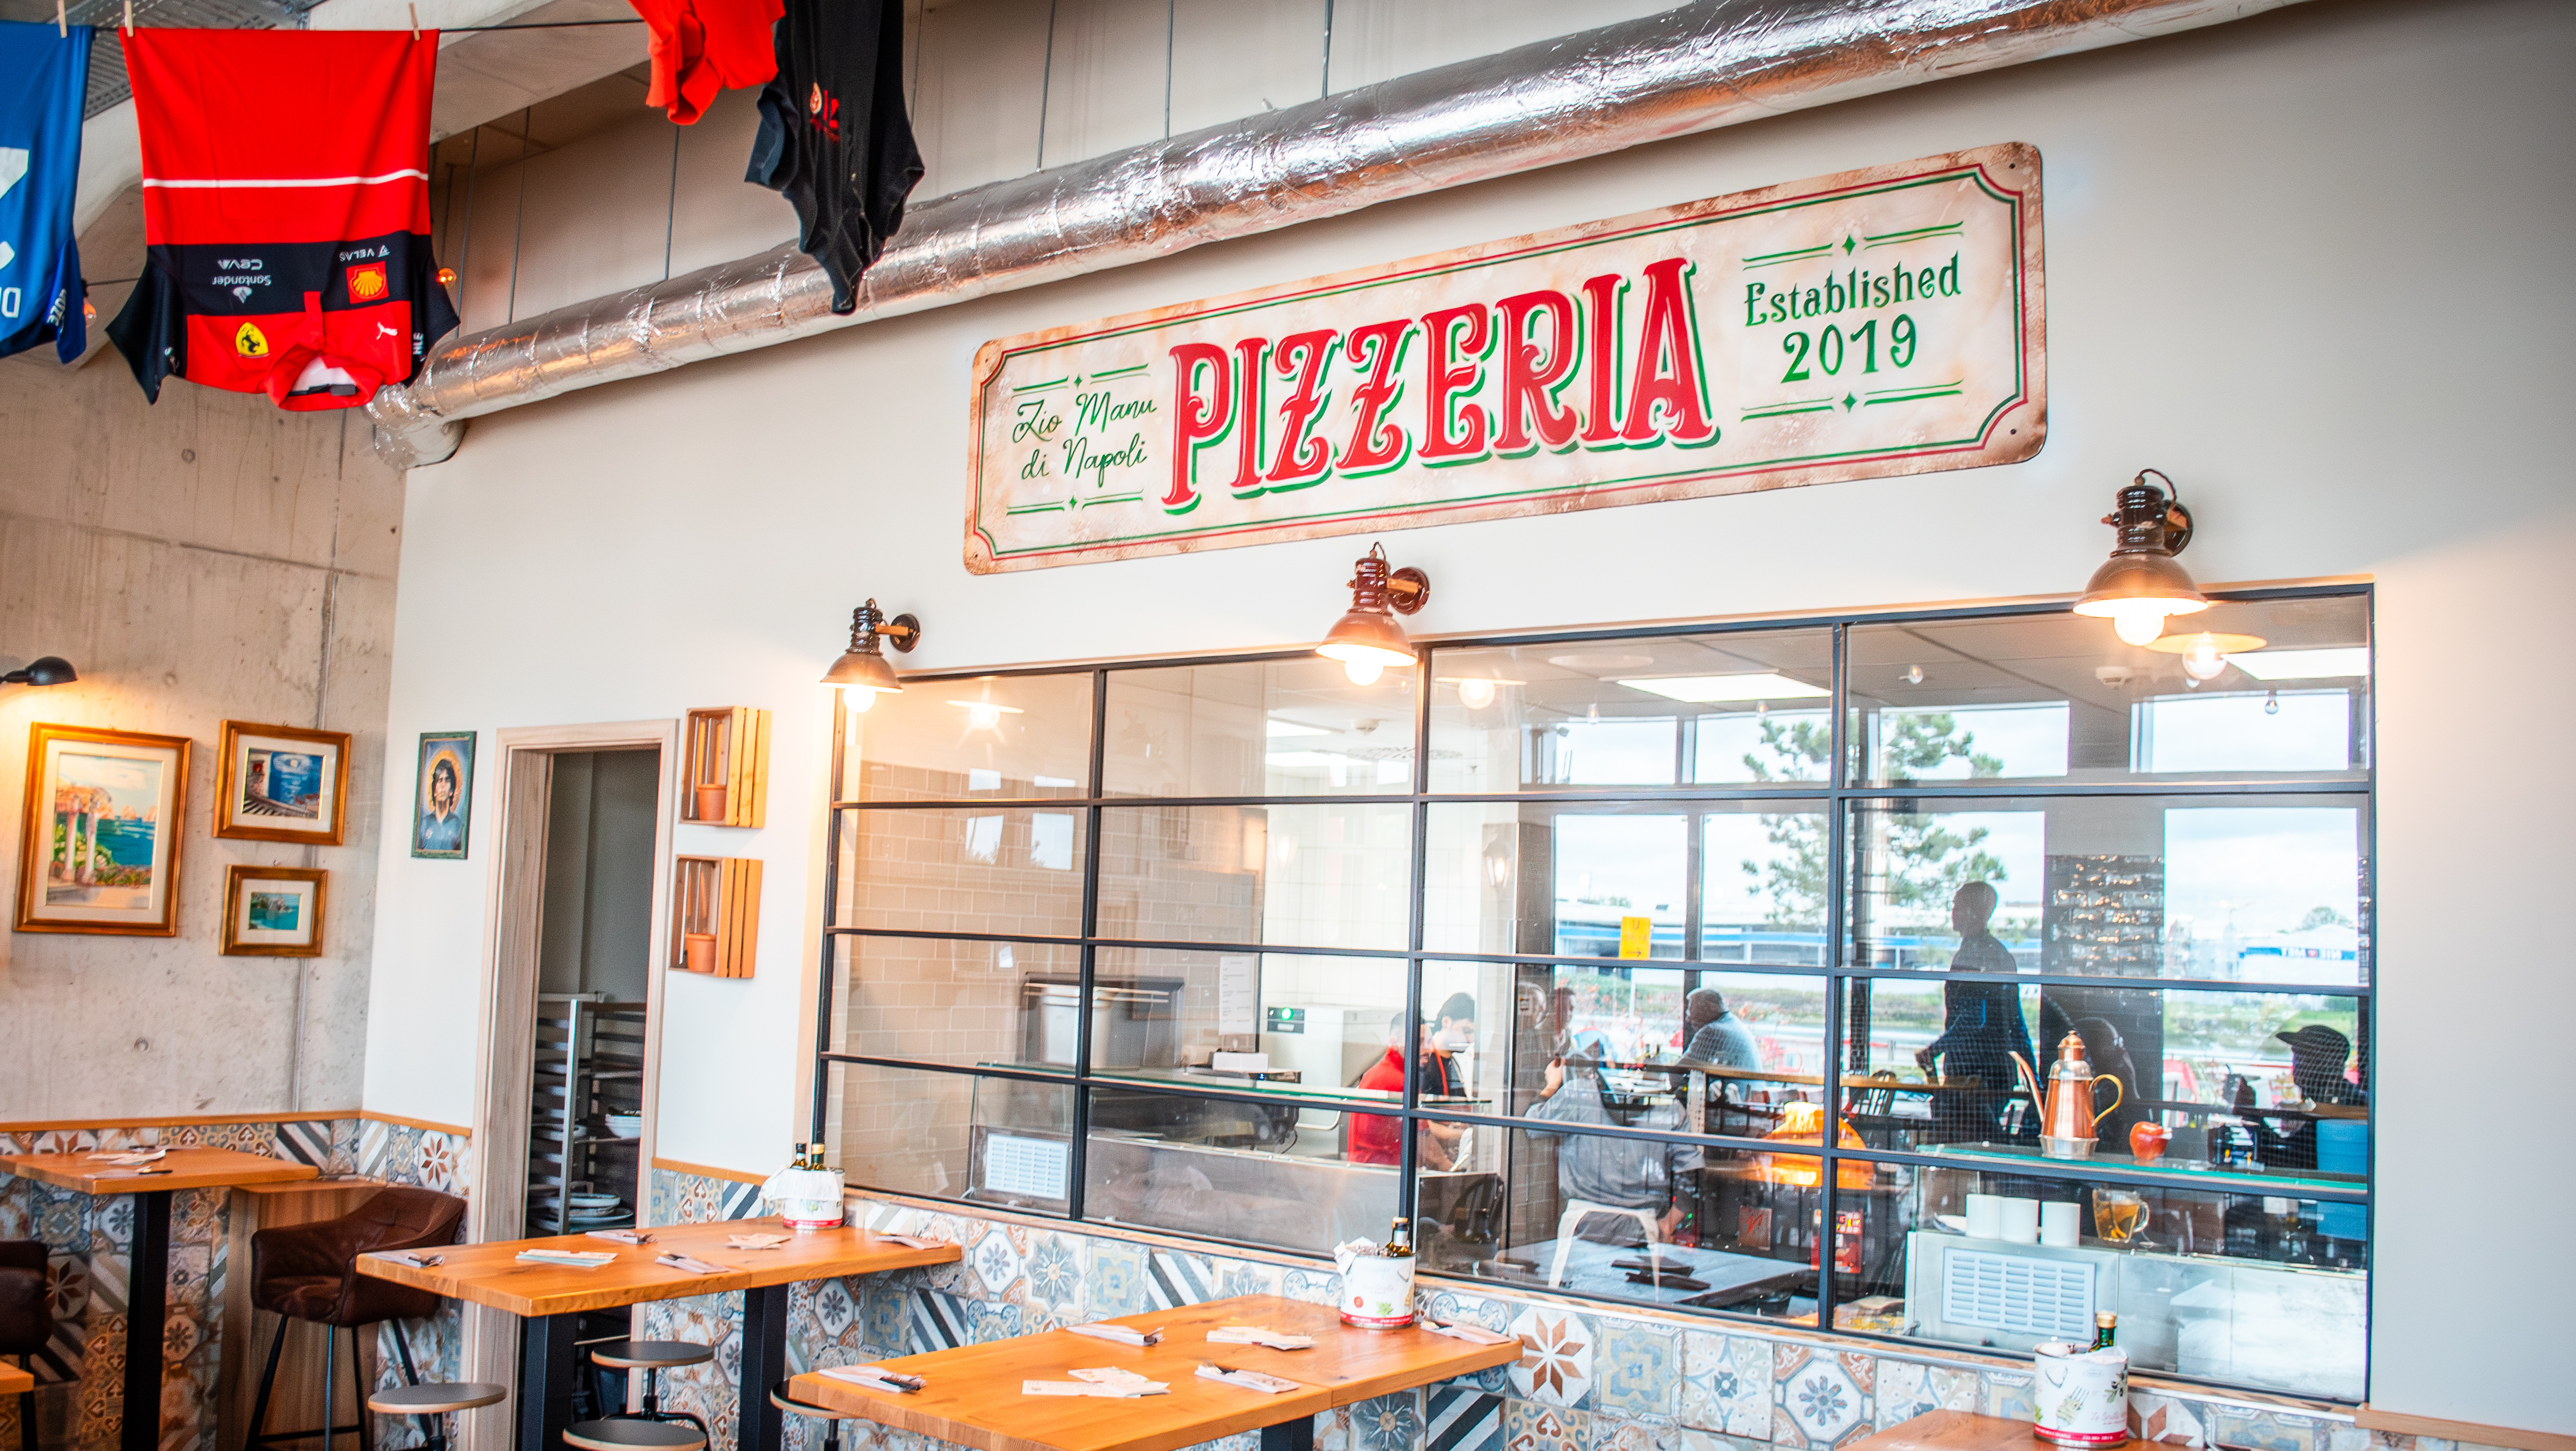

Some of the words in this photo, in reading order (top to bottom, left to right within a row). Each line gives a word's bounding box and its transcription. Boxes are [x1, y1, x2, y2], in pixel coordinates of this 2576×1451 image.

[212, 275, 272, 287] Santander
[1744, 250, 1962, 327] Established
[1780, 314, 1917, 383] 2019
[1161, 257, 1721, 515] PIZZERIA
[1012, 399, 1063, 444] Zio
[1075, 392, 1158, 436] Manu
[1021, 449, 1050, 480] di
[1063, 433, 1148, 488] Napoli
